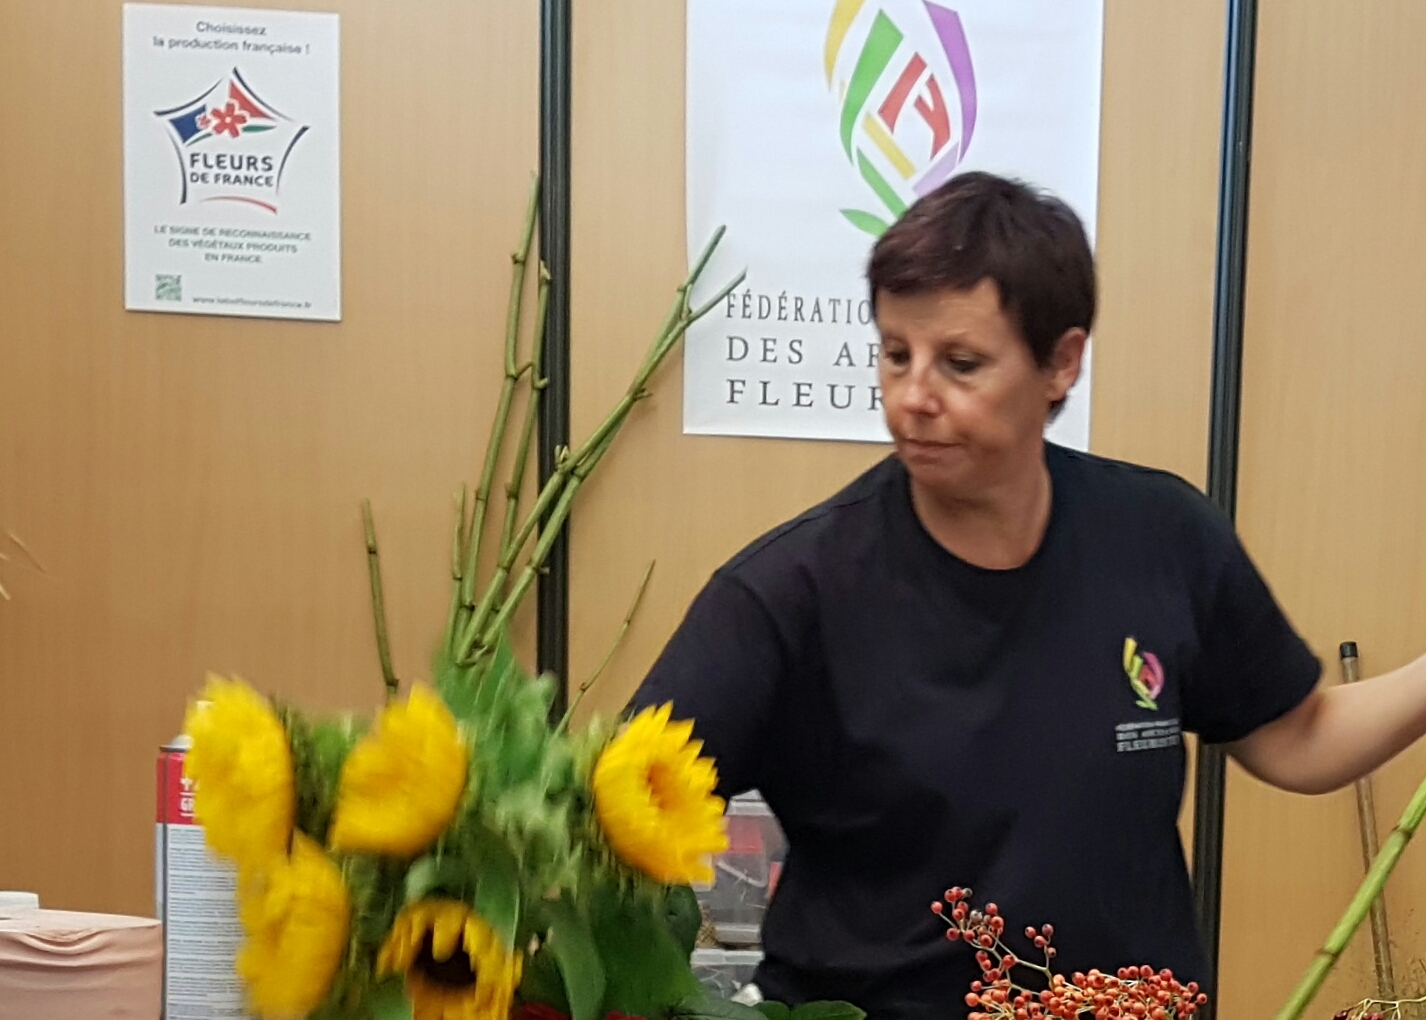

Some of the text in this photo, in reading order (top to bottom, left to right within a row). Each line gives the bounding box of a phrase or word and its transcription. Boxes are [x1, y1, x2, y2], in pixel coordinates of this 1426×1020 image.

[196, 21, 267, 36] Choisissez
[153, 36, 164, 47] la
[168, 38, 238, 51] production
[242, 39, 302, 55] française
[190, 152, 273, 172] FLEURS
[190, 172, 274, 188] DE FRANCE
[154, 224, 311, 241] LE SIGNE DE RECONNAISSANCE
[169, 238, 189, 247] DES
[246, 243, 298, 253] PRODUITS
[205, 252, 262, 263] EN FRANCE
[725, 289, 872, 325] FÉDÉRATIO
[726, 336, 880, 368] DES AR
[726, 379, 883, 411] FLEUR
